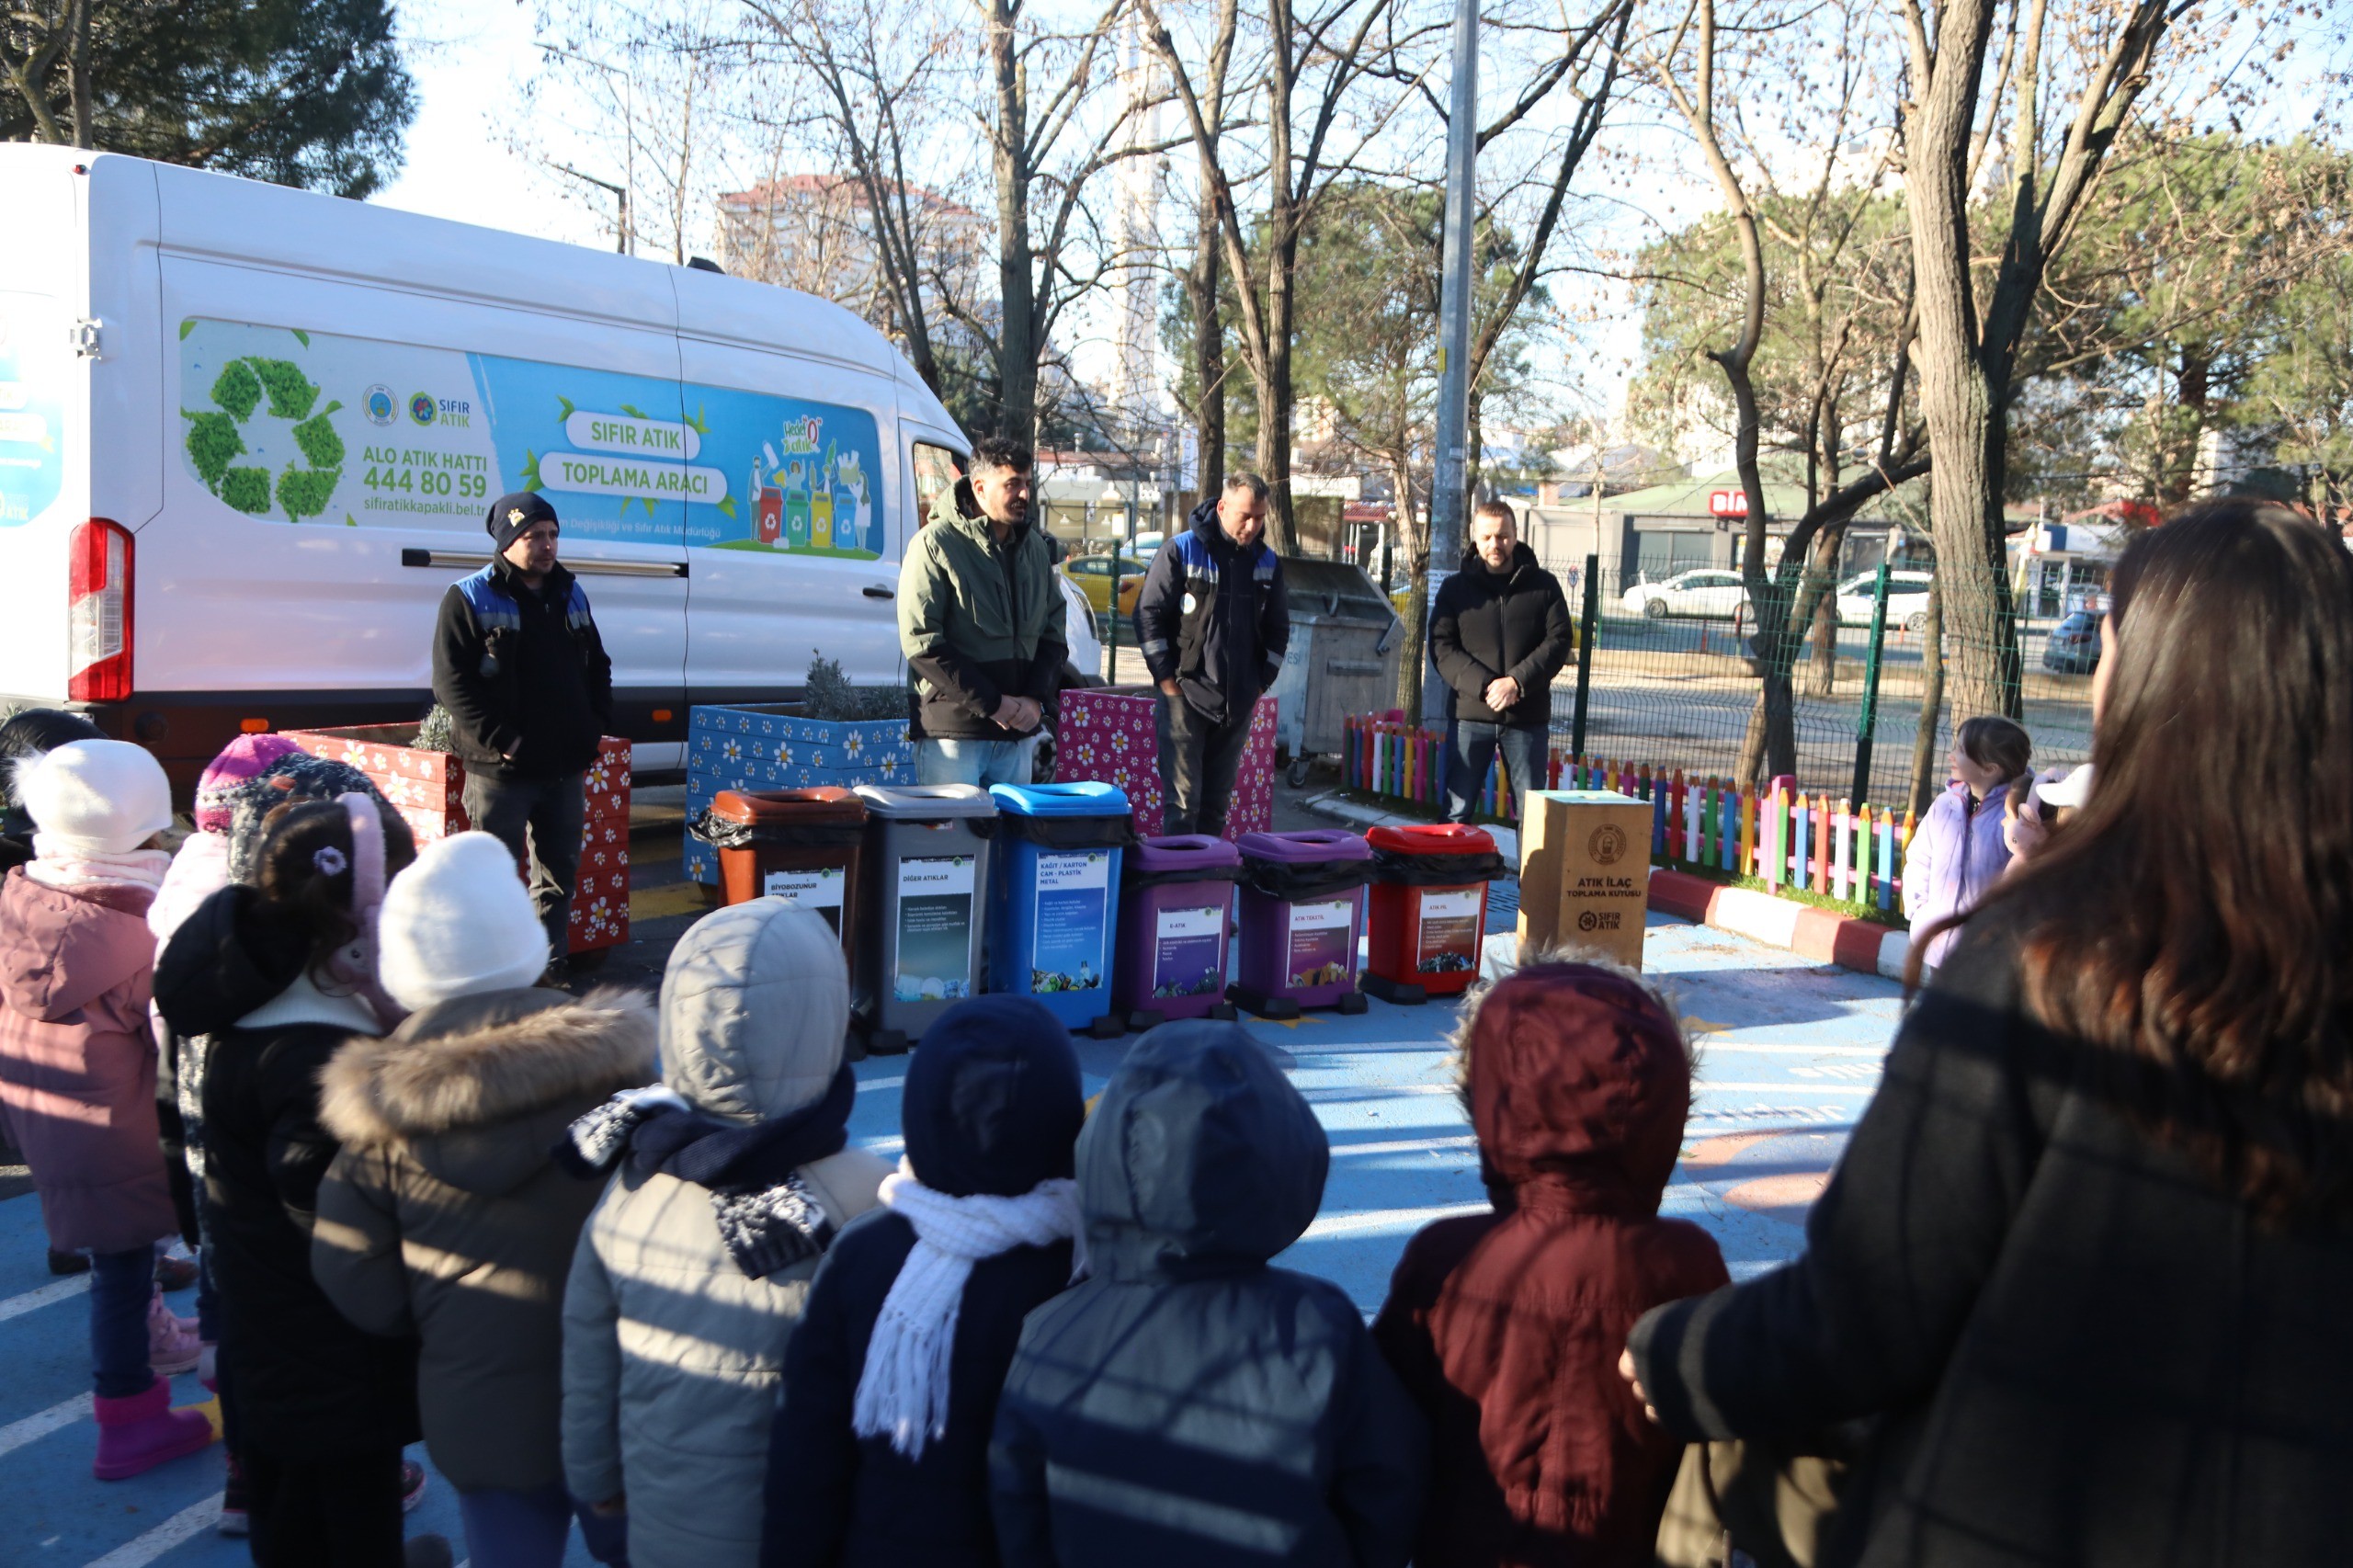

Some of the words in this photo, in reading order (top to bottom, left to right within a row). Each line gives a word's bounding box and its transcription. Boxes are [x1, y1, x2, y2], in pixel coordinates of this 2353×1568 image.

[439, 399, 470, 414] SIFIR
[440, 413, 470, 427] ATIK
[591, 421, 637, 445] SIFIR
[642, 427, 680, 449] ATIK
[363, 446, 397, 464] ALO
[402, 449, 438, 468] ATIK
[443, 452, 487, 472] HATTI
[363, 466, 414, 493] 444
[420, 471, 451, 495] 80
[459, 473, 487, 498] 59
[563, 462, 651, 489] TOPLAMA
[656, 471, 708, 494] ARACI
[364, 497, 486, 516] sifiratikkapakli.bel.tr
[621, 524, 633, 532] ve
[1578, 877, 1603, 887] ATIK
[1607, 876, 1632, 889] İLAÇ
[1599, 912, 1621, 920] SIFIR
[1598, 921, 1620, 929] ATIK
